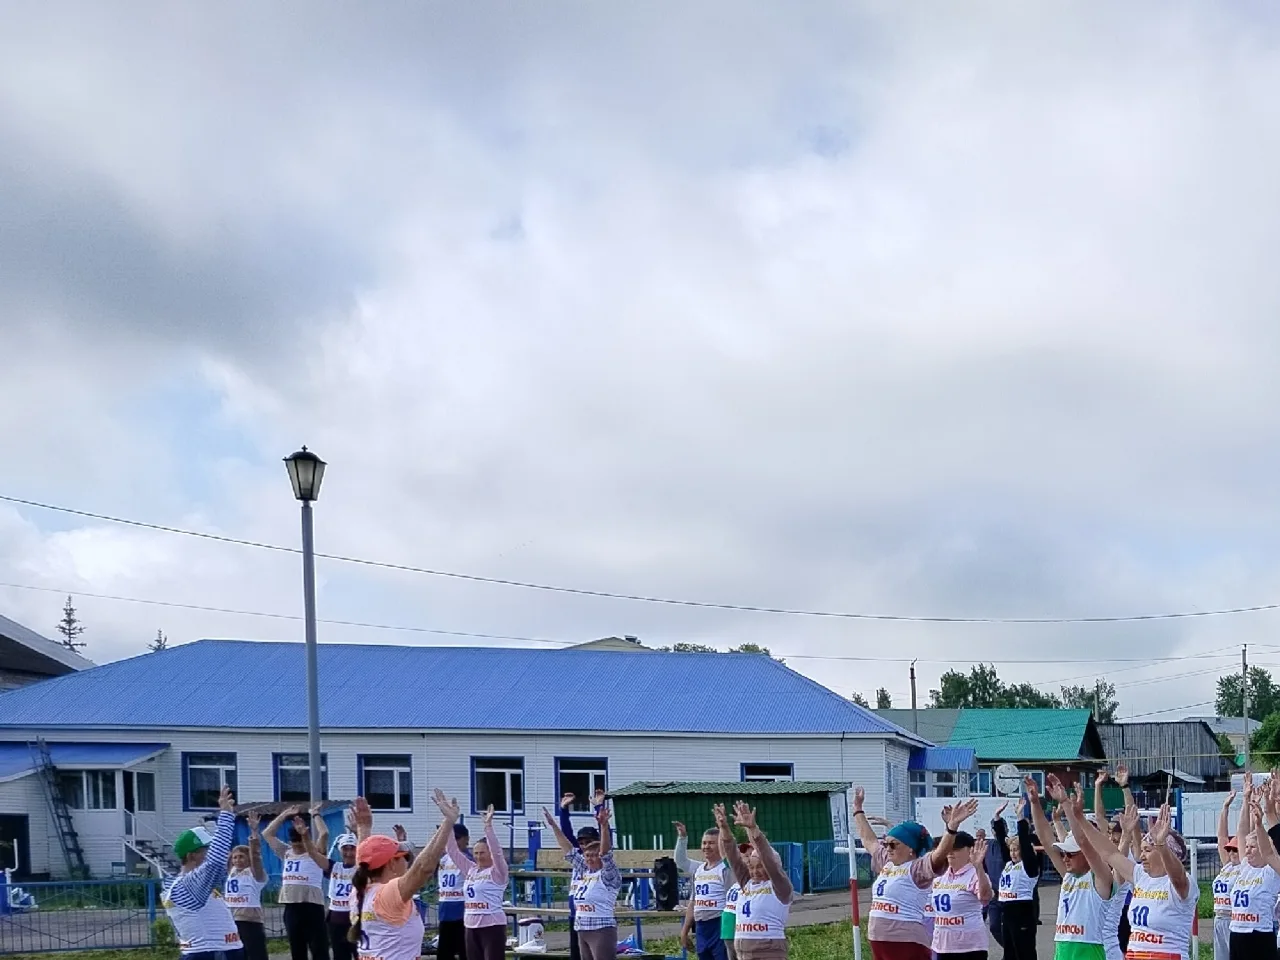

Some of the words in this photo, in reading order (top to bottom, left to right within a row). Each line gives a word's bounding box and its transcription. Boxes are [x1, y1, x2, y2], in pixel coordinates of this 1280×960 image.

[441, 873, 456, 888] 30
[467, 883, 476, 899] 5
[1232, 889, 1250, 907] 25
[742, 900, 751, 918] 4
[933, 893, 952, 912] 19
